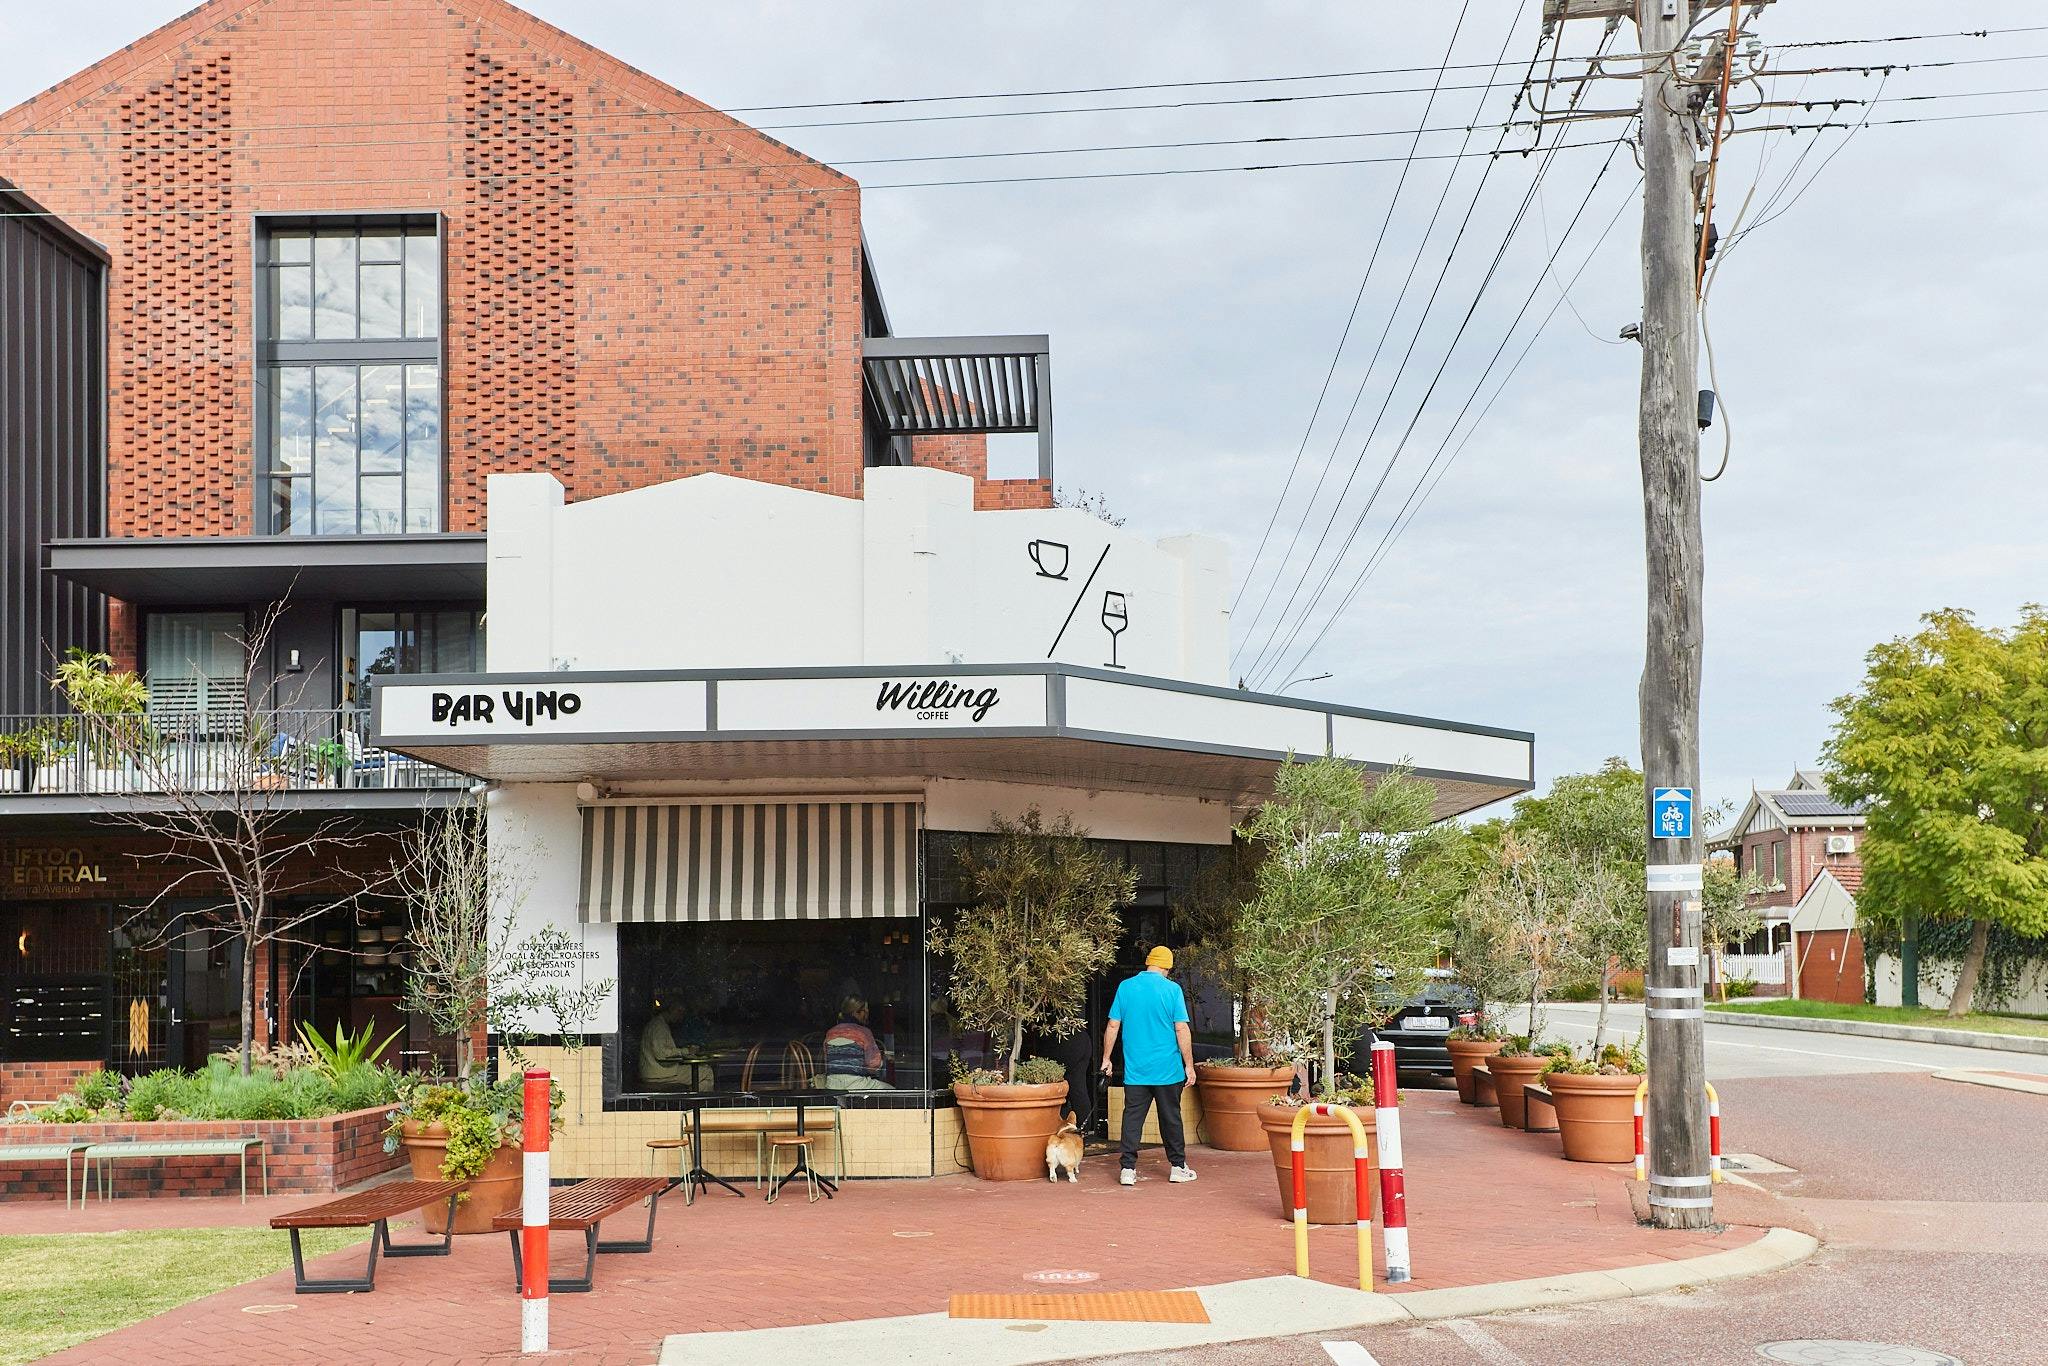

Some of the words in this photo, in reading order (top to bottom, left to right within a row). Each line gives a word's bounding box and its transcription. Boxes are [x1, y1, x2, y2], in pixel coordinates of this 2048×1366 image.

[876, 680, 1000, 722] Willing
[432, 693, 495, 726] BAR
[502, 691, 581, 726] VINO
[916, 711, 949, 720] COFFEE
[1662, 821, 1676, 832] NE
[1677, 821, 1684, 832] 8
[517, 943, 546, 951] COFE
[559, 951, 600, 960] ROASTERS
[531, 970, 571, 978] GRANOLA
